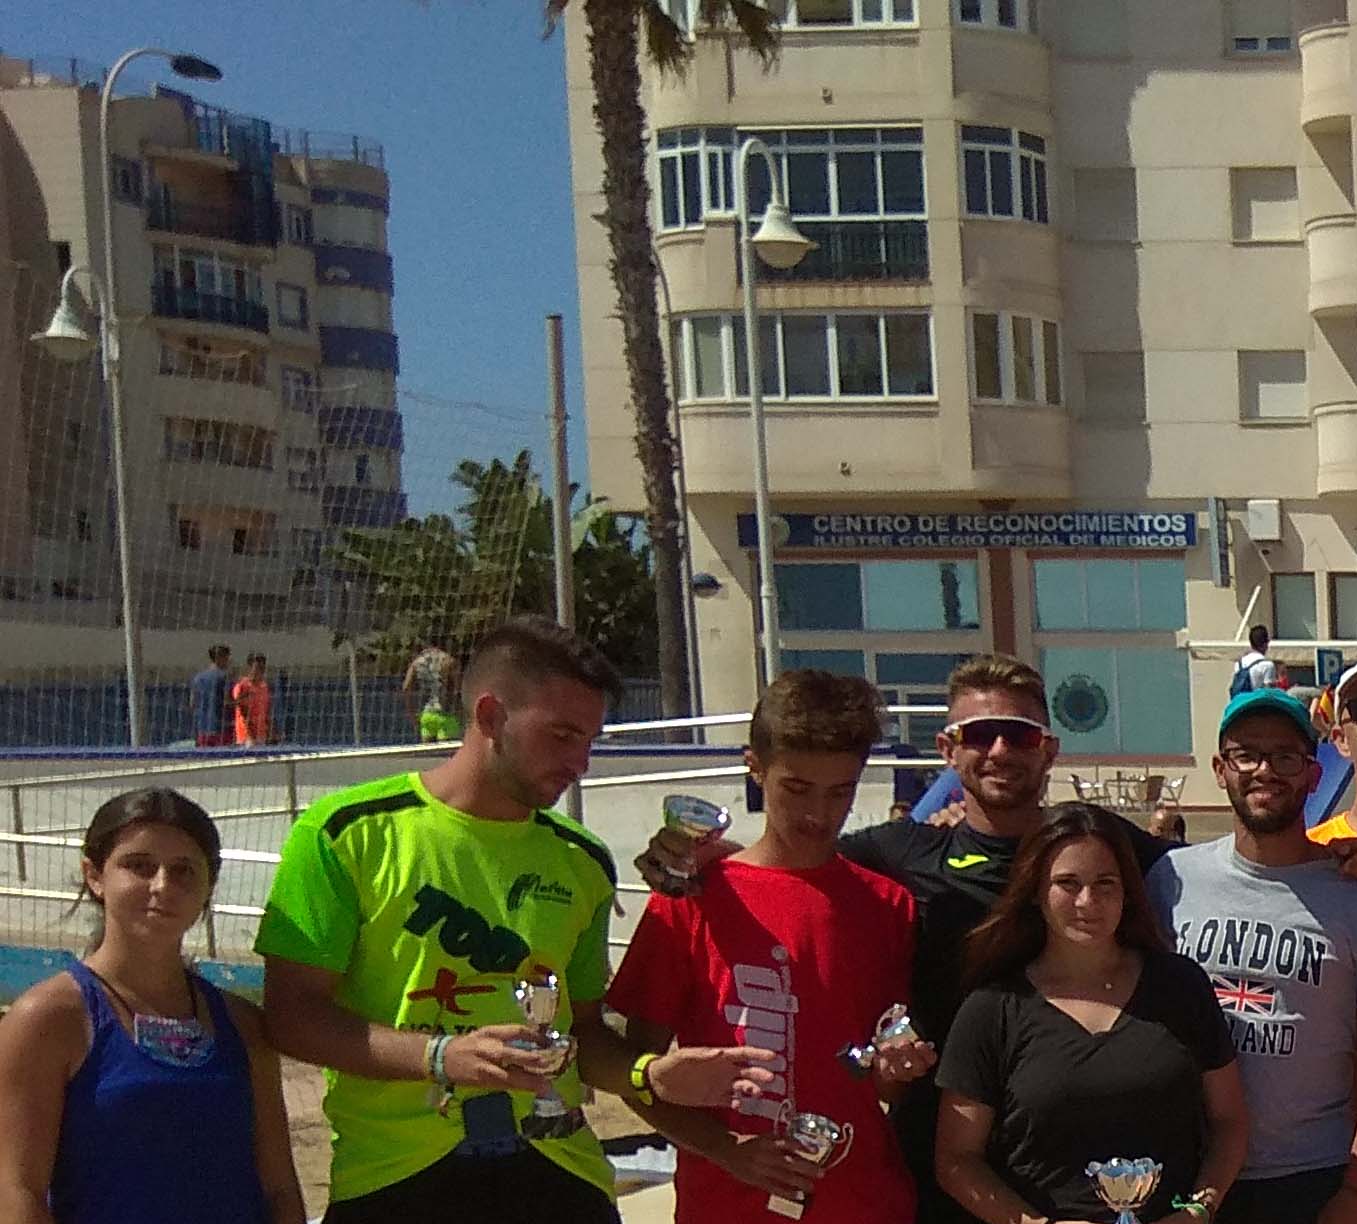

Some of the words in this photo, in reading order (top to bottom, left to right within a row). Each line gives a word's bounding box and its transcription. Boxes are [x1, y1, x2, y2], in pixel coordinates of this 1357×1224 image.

[813, 515, 912, 533] CENTRO
[918, 515, 950, 533] DE
[956, 514, 1187, 533] RECONOCIMIENTOS
[814, 535, 894, 547] ILUSTRE
[898, 535, 985, 547] COLEGIO
[989, 535, 1065, 547] OFICIAL
[1324, 652, 1339, 681] P
[1177, 918, 1327, 987] LONDON
